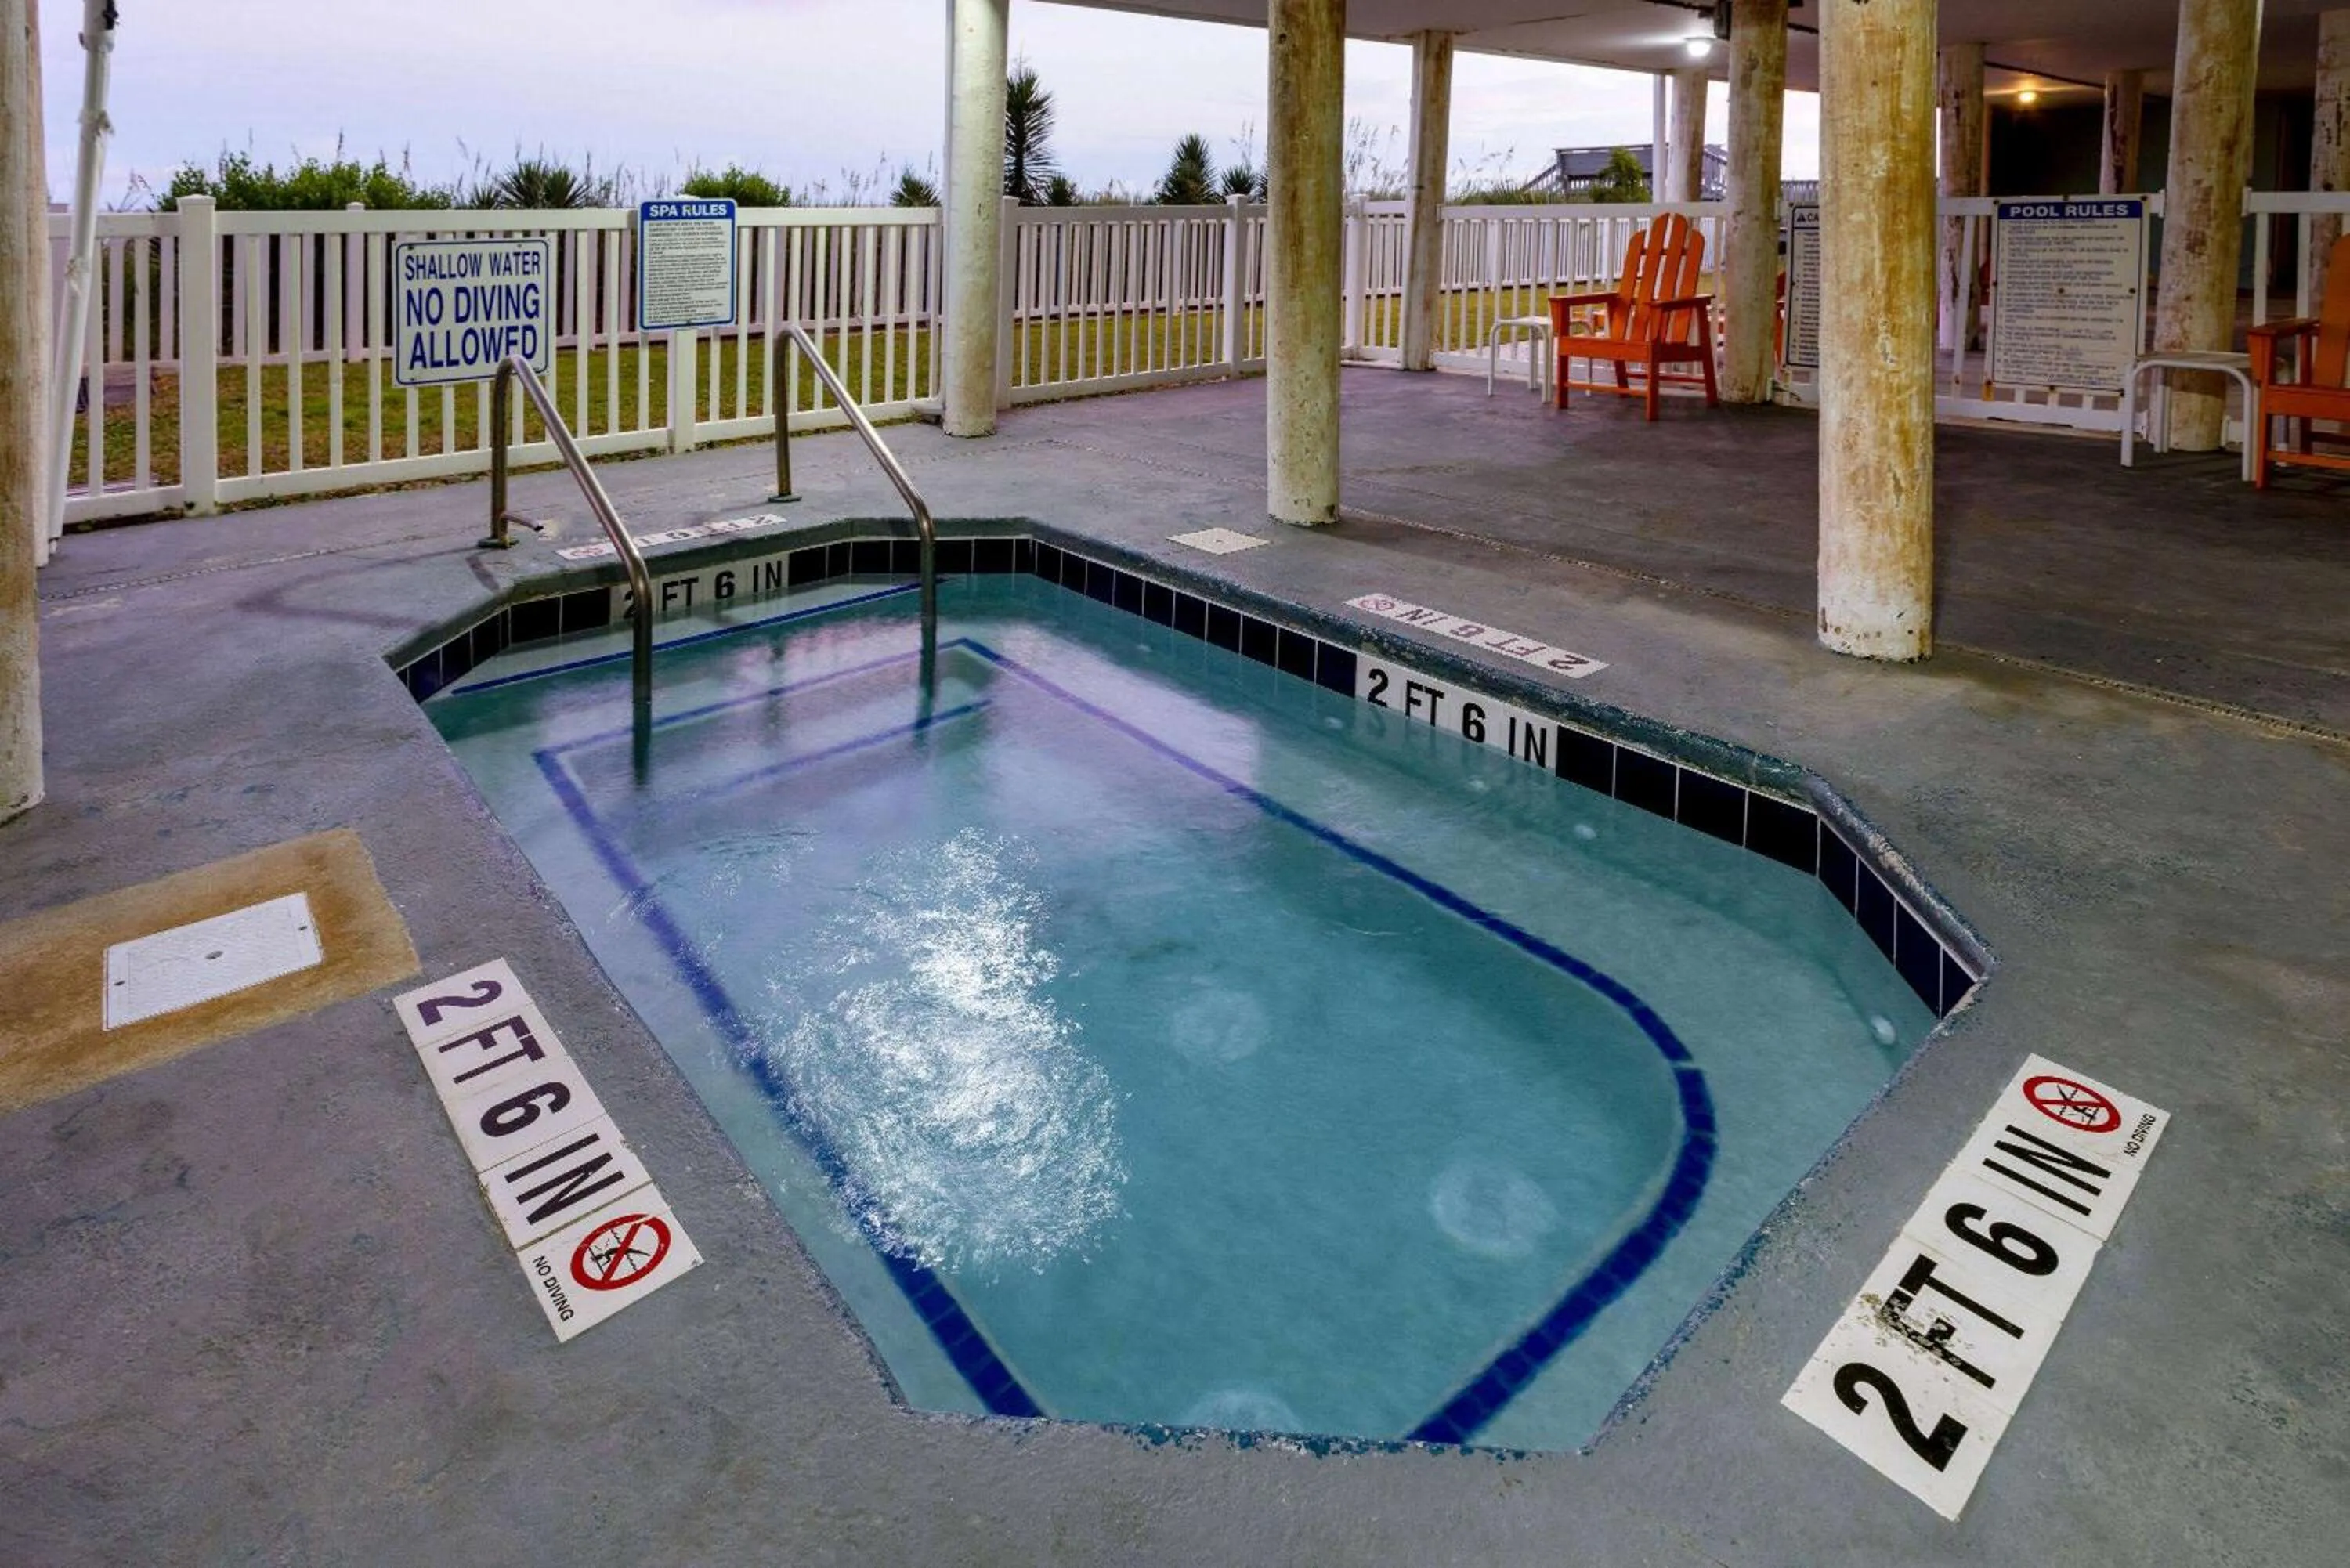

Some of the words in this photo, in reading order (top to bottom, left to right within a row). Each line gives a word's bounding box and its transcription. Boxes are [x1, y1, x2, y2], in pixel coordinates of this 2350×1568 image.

[649, 204, 678, 217] SPA
[682, 204, 728, 216] RULES
[2009, 205, 2059, 217] POOL
[2064, 204, 2129, 216] RULES
[405, 253, 483, 280] SHALLOW
[489, 251, 540, 276] WATER
[407, 287, 443, 327] NO
[454, 283, 540, 323] DIVING
[410, 324, 537, 370] ALLOWED
[662, 576, 699, 612] FT
[714, 570, 736, 600] 6
[753, 560, 783, 593] IN
[1395, 609, 1448, 626] IN
[1485, 638, 1547, 657] FT
[1547, 654, 1590, 670] 2
[1368, 668, 1389, 708] 2
[1405, 679, 1444, 727] FT
[1462, 703, 1486, 742] 6
[1509, 717, 1547, 768] IN
[417, 979, 503, 1027] 2
[439, 1014, 546, 1084] FT
[480, 1081, 571, 1138] 6
[2131, 1113, 2156, 1142] DIVING
[1982, 1124, 2112, 1216] IN
[2124, 1141, 2141, 1158] NO
[504, 1133, 626, 1226] IN
[1944, 1202, 2059, 1276] 6
[533, 1255, 551, 1276] NO
[543, 1276, 574, 1321] DIVING
[1880, 1253, 2025, 1389] FT
[1833, 1362, 1969, 1473] 2
